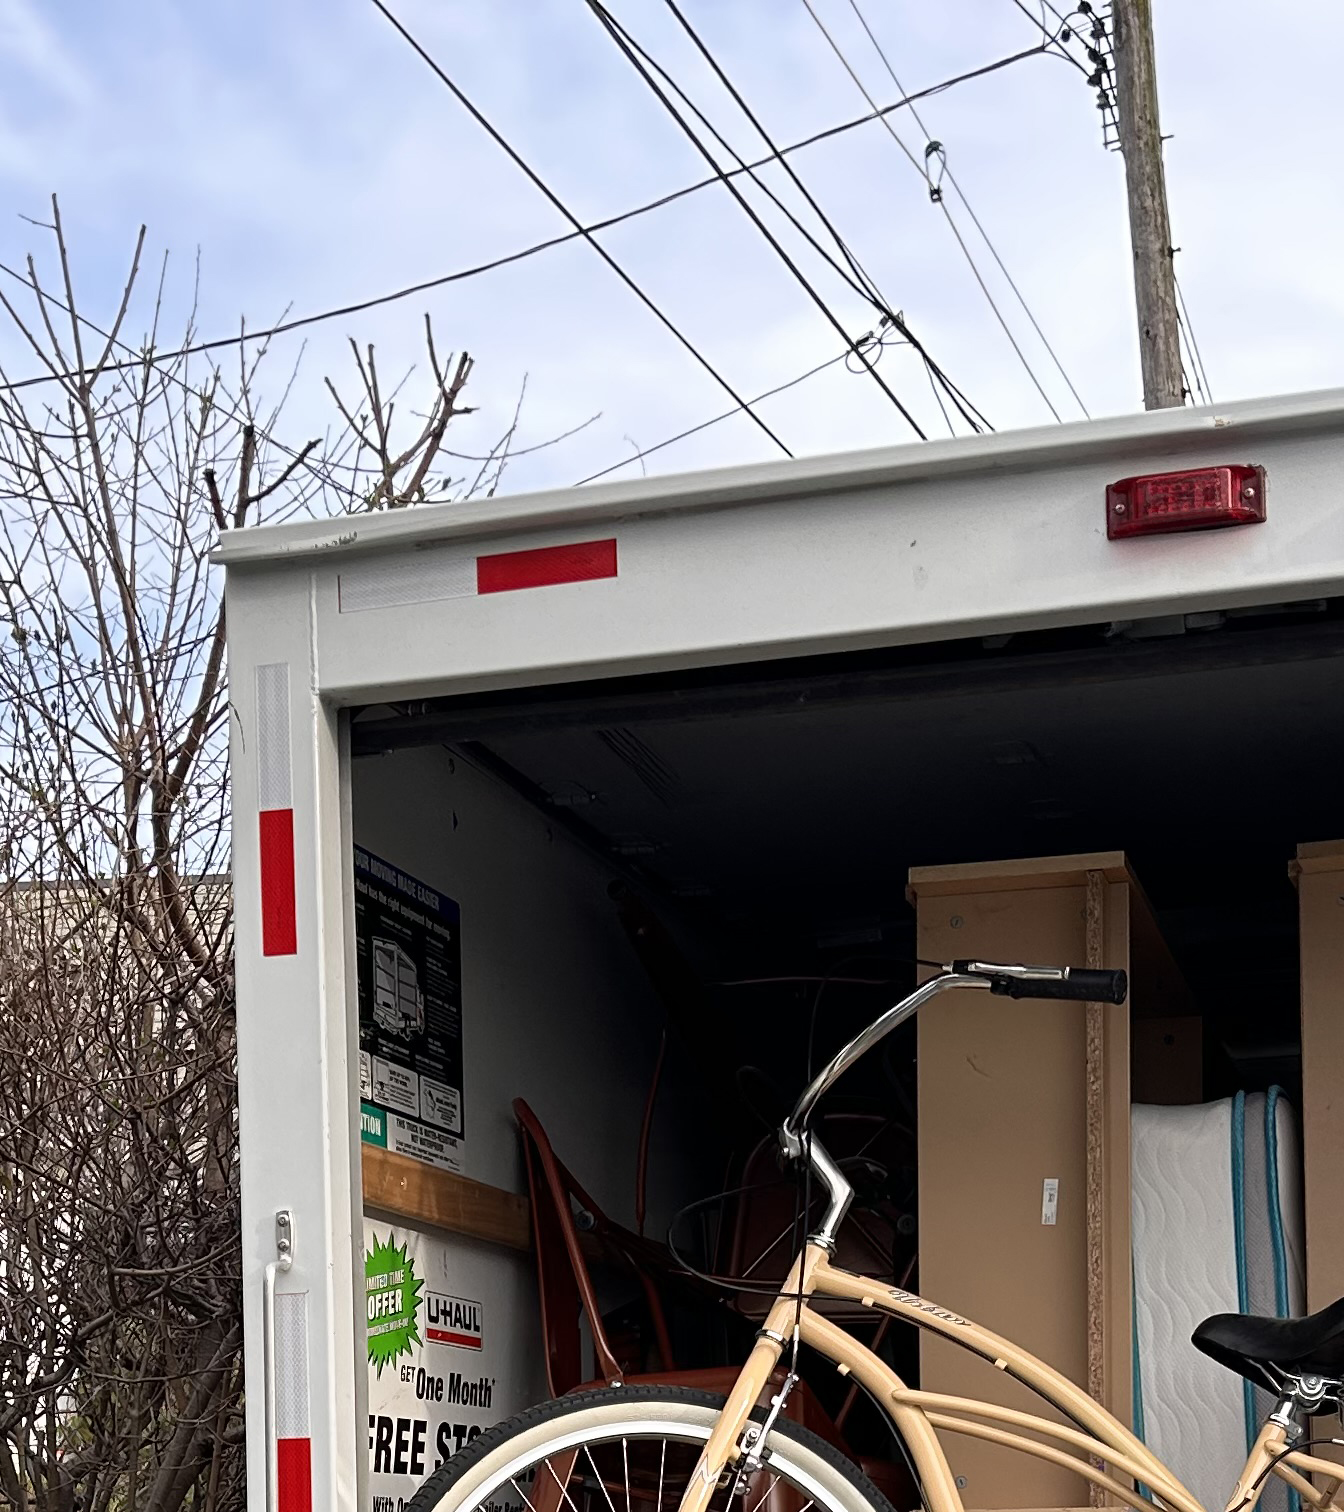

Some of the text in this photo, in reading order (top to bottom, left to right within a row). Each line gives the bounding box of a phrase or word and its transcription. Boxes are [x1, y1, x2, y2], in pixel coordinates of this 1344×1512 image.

[366, 1273, 388, 1290] IMITED
[368, 1289, 403, 1320] OFFER
[401, 1365, 415, 1383] GET
[416, 1367, 443, 1402] One
